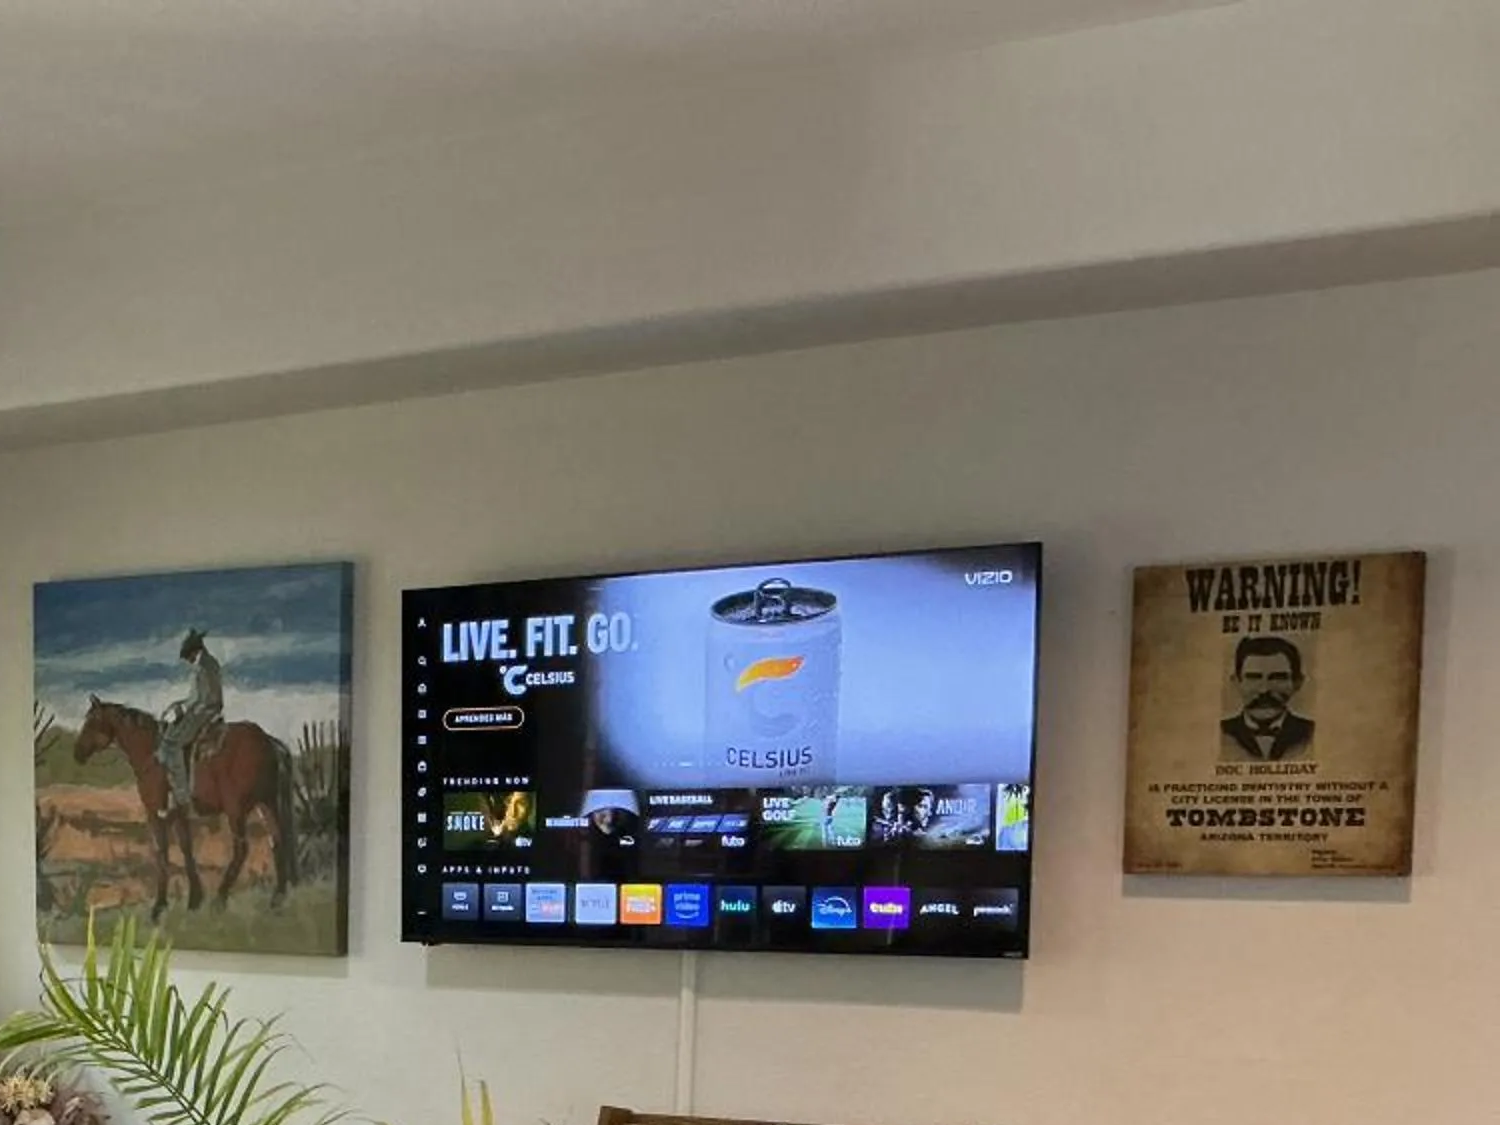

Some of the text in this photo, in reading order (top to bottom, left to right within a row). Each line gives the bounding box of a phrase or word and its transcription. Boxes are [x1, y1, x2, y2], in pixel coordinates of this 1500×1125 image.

[964, 570, 1014, 585] VIZIO
[1185, 560, 1362, 613] WARNING!
[1248, 614, 1262, 633] IT
[1269, 612, 1322, 632] KNOWN
[442, 611, 639, 663] LIVE. FIT. GO.
[525, 671, 576, 686] CELSIUS
[725, 746, 814, 769] CELSIUS
[1215, 762, 1319, 776] DOC HOLLIDAY
[1315, 781, 1375, 792] WITHOUT
[1378, 781, 1389, 791] A
[762, 797, 791, 809] LIVE
[1171, 795, 1199, 805] CITY
[1276, 794, 1301, 804] THE
[1305, 794, 1339, 804] TOWN
[1345, 793, 1363, 803] OF
[762, 809, 797, 822] GOLF
[1166, 807, 1366, 827] TOMBSTONE
[1200, 832, 1330, 842] ARIZONA TERRITORY
[720, 899, 750, 912] hulu
[919, 903, 961, 915] ANGEL
